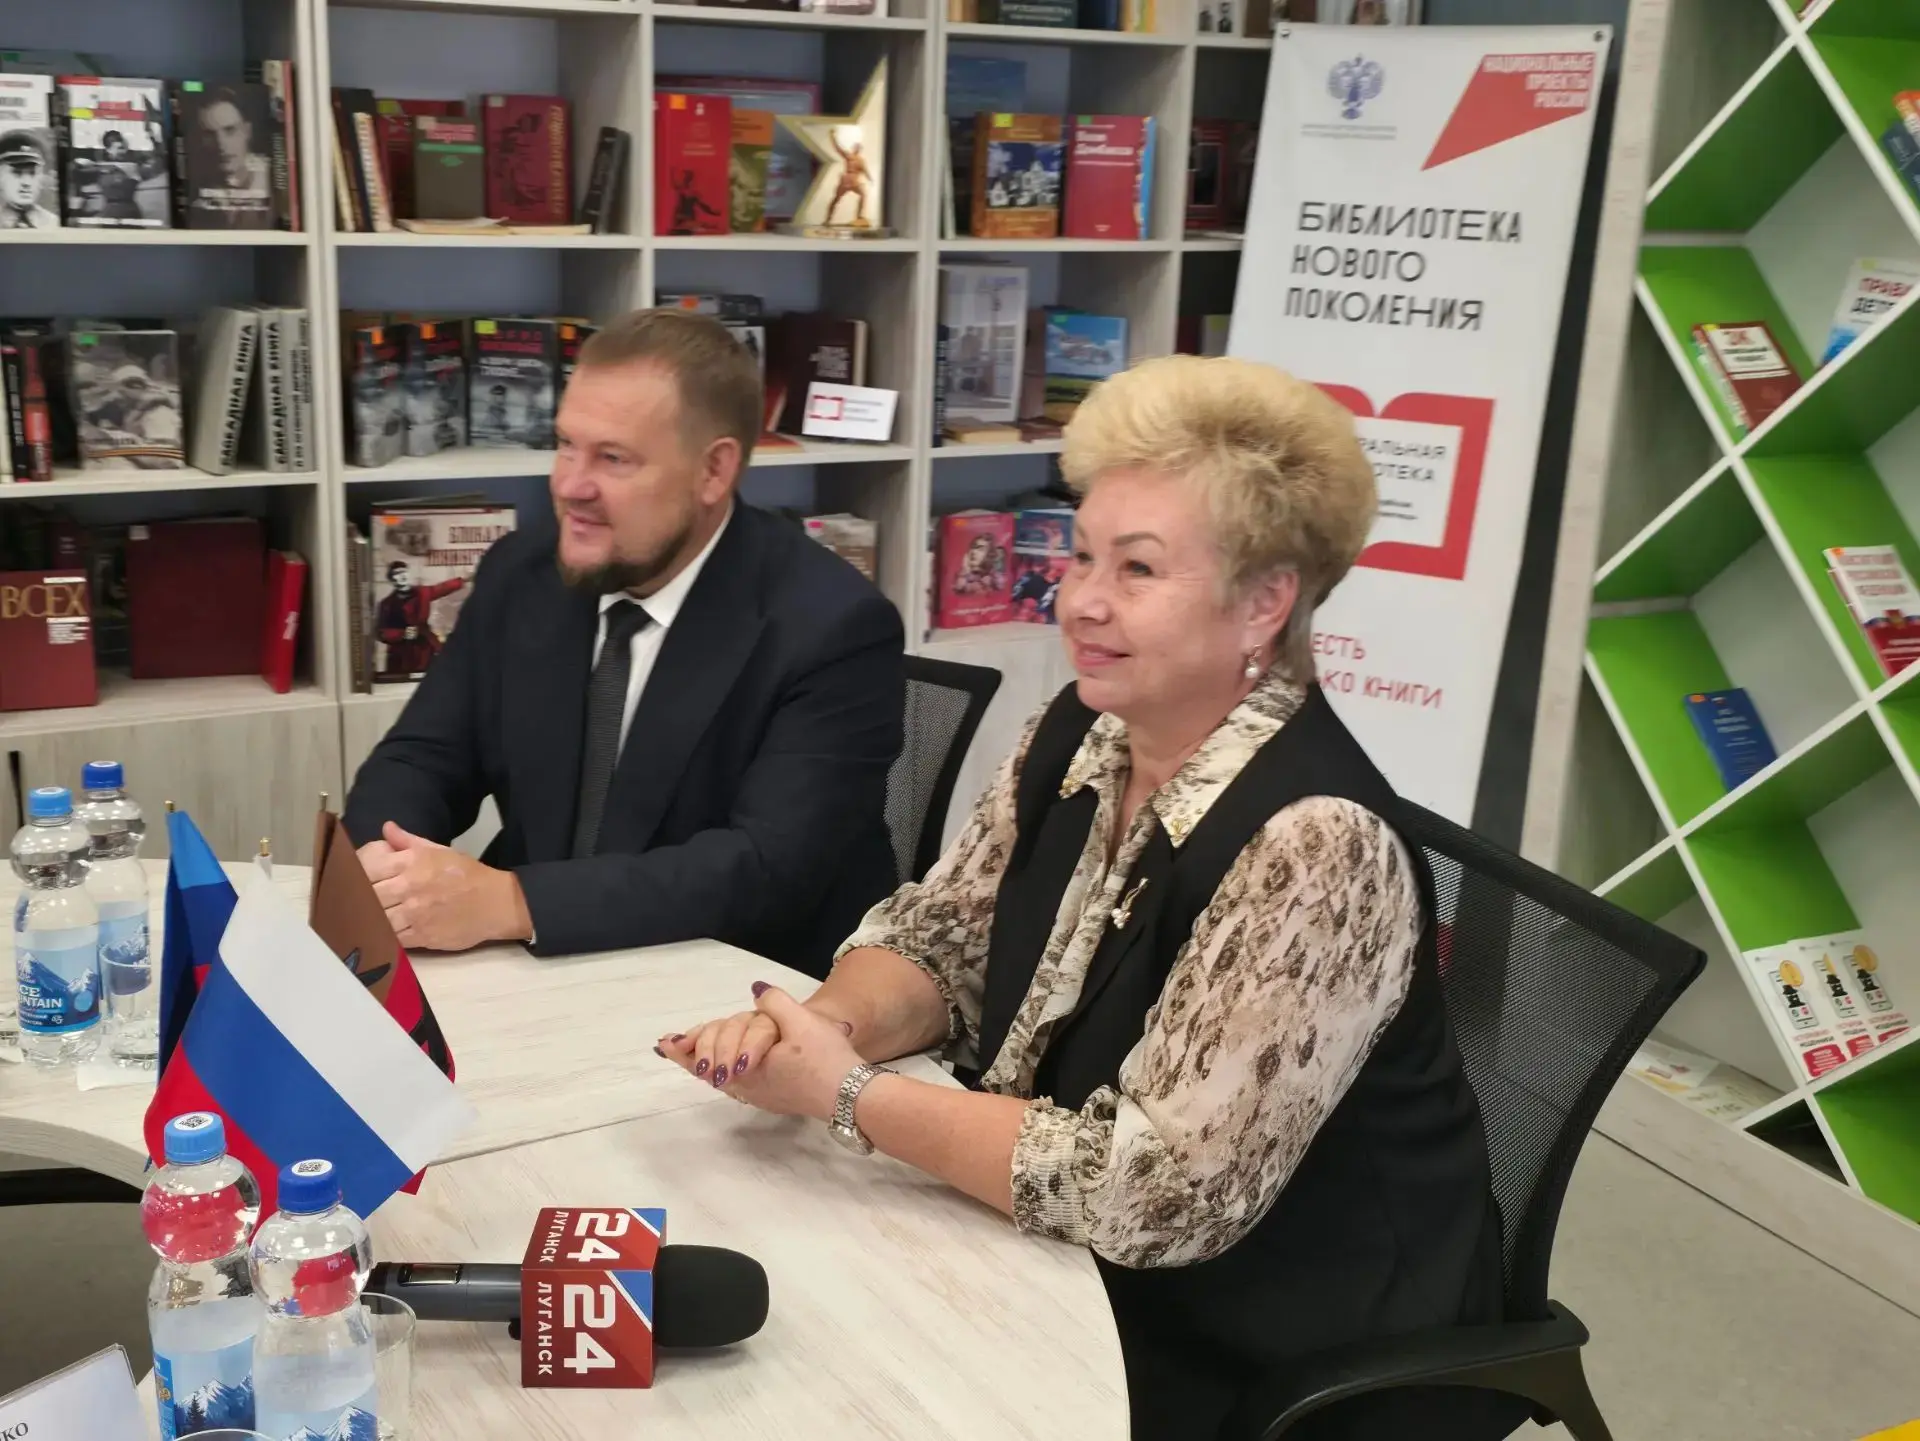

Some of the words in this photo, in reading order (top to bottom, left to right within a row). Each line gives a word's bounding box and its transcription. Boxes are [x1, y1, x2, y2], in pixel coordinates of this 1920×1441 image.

[1297, 200, 1522, 243] БИБЛИОТЕКА
[1290, 244, 1426, 282] НОВОГО
[1284, 286, 1484, 331] ПОКОЛЕНИЯ
[1358, 437, 1447, 460] РАЛЬНАЯ
[1371, 462, 1435, 482] ОТЕКА
[0, 584, 88, 618] ВСЕХ
[1311, 632, 1366, 660] ЕСТЬ
[1363, 675, 1444, 709] КНИГИ
[19, 984, 41, 997] CE
[539, 1210, 570, 1263] ЛУГАНСК
[567, 1212, 631, 1263] 24
[537, 1281, 553, 1376] ЛУГАНСК
[563, 1284, 616, 1374] 24
[0, 1422, 29, 1441] КО
